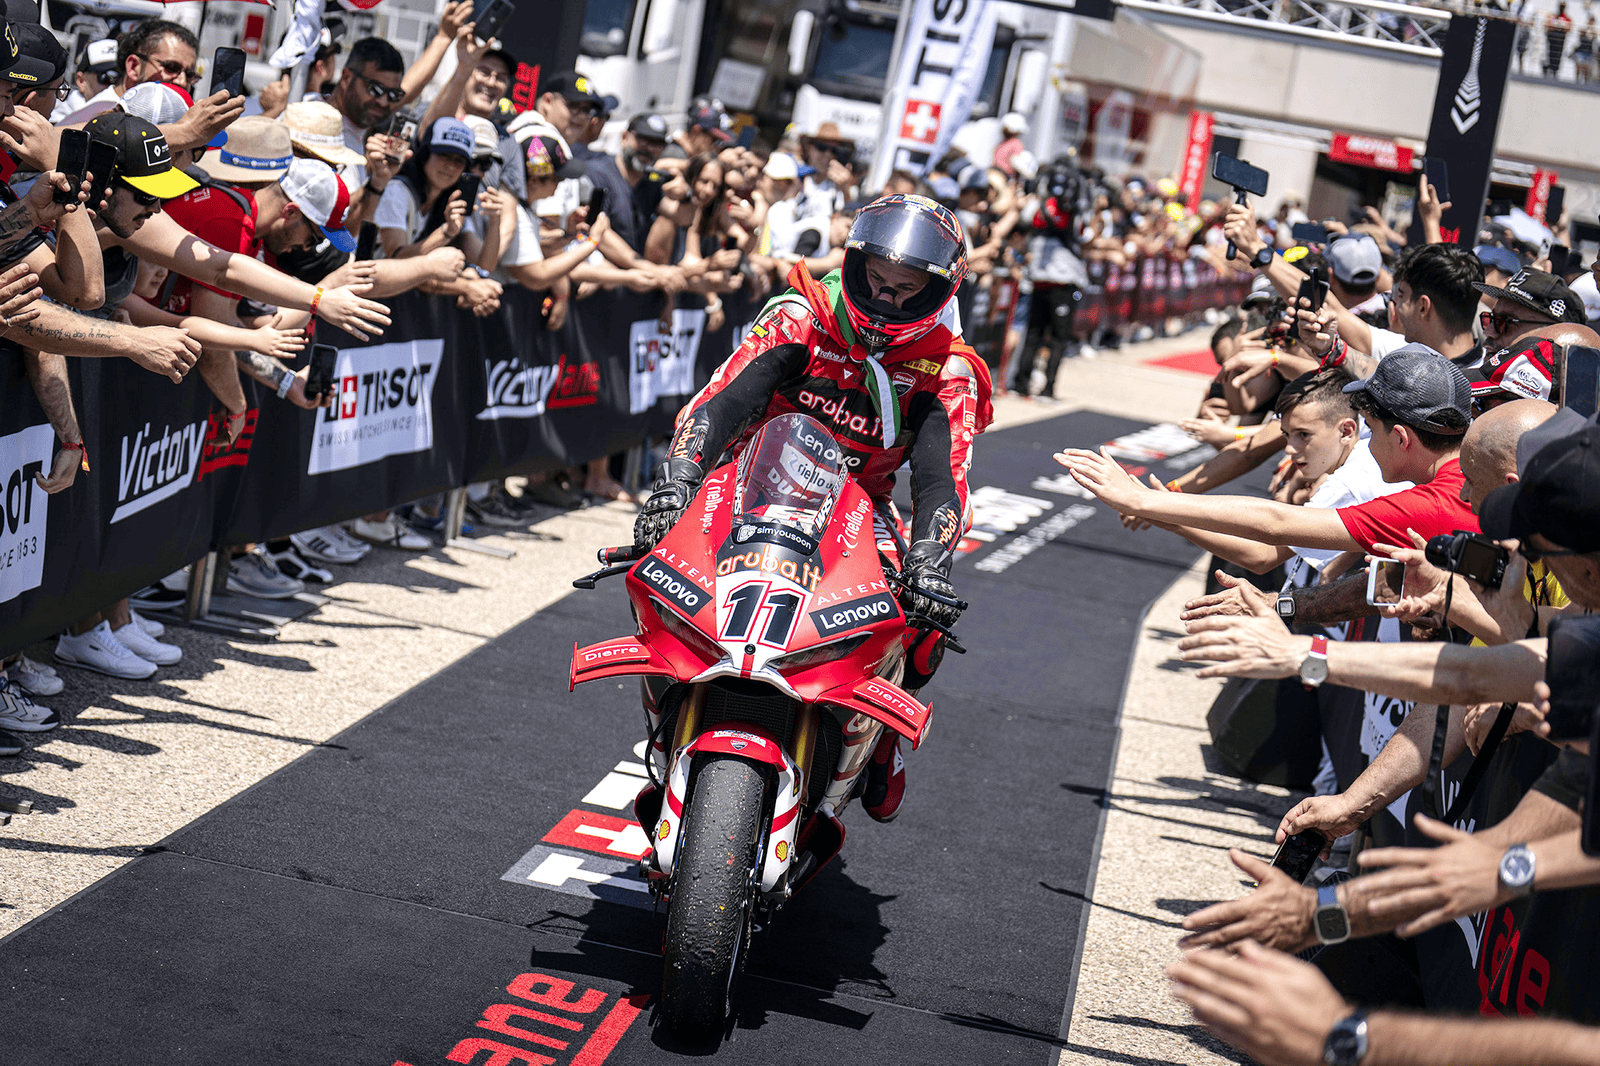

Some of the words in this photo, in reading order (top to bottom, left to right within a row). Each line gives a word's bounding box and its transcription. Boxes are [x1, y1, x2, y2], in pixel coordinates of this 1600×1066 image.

[798, 390, 884, 441] aruba.i
[796, 423, 861, 467] Lenovo
[112, 420, 208, 514] Victory
[797, 463, 826, 488] riello
[704, 485, 724, 513] riello
[700, 513, 714, 529] ups
[757, 526, 812, 550] simyousoon
[844, 510, 865, 541] riello
[858, 498, 871, 517] ups
[642, 561, 698, 606] Lenovo
[655, 548, 714, 588] ALTEN
[717, 543, 821, 592] aruba.it
[817, 580, 886, 605] ALTEN
[719, 580, 806, 650] 11
[820, 600, 890, 630] Lenovo
[585, 646, 639, 662] Dierre
[867, 684, 915, 716] Dierre
[391, 972, 608, 1066] ane
